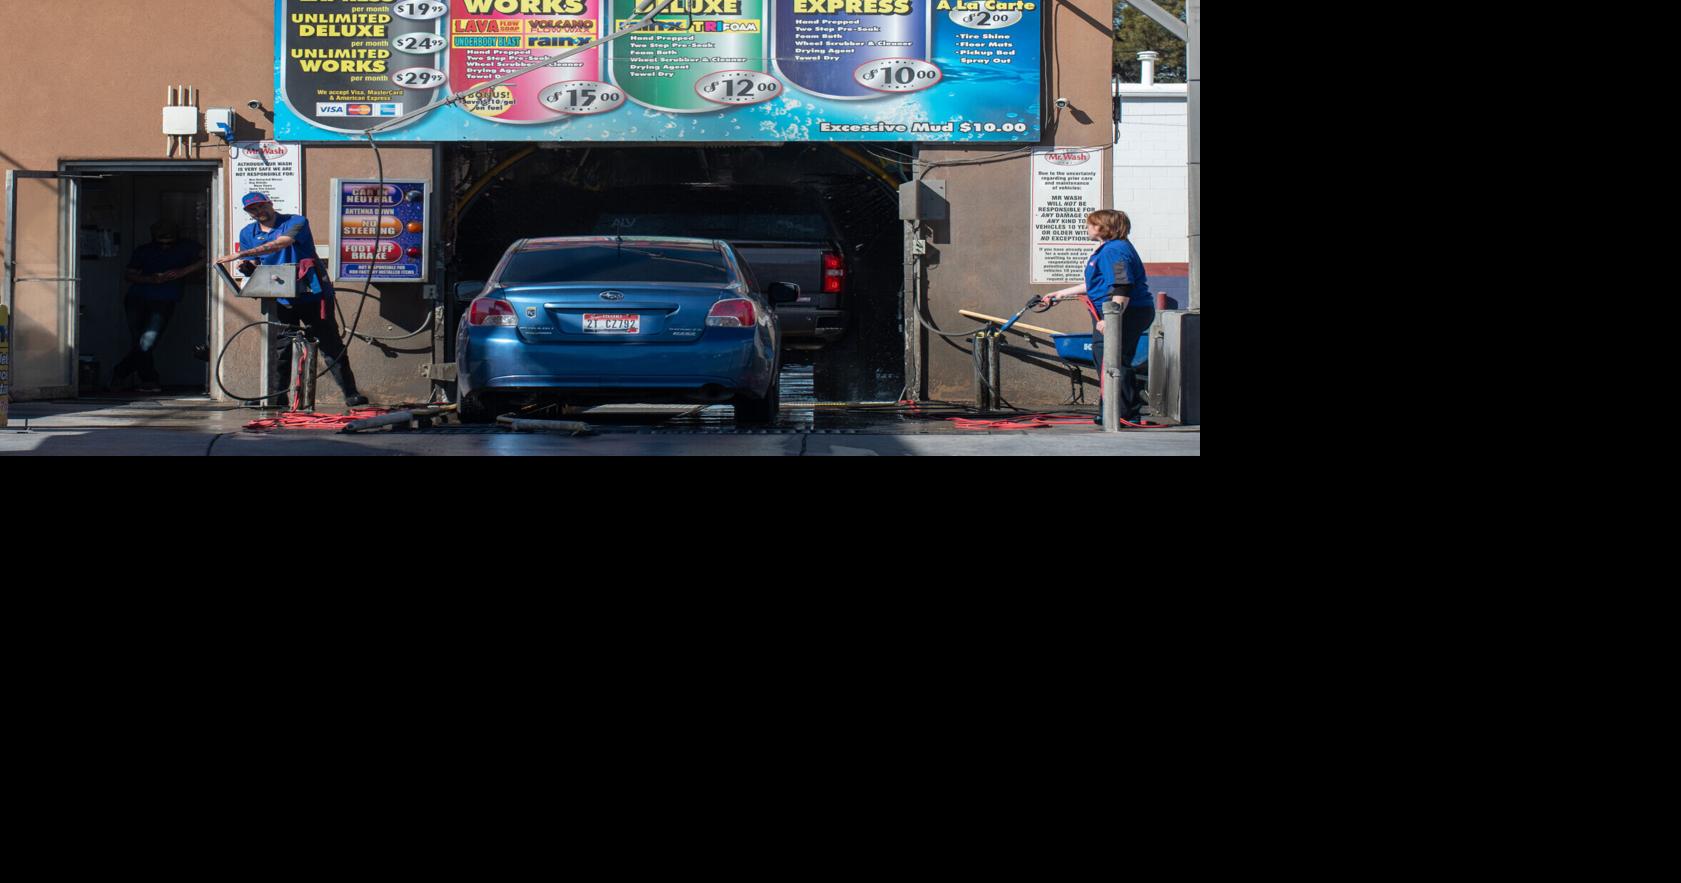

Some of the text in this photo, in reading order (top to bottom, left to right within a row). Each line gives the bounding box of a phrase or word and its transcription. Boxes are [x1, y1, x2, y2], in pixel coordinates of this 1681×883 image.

[464, 0, 584, 14] WORKS
[794, 0, 911, 13] EXPRESS
[937, 0, 1035, 10] A La Carte
[291, 14, 392, 23] UNLIMITED
[455, 20, 499, 32] LAVA
[528, 20, 594, 29] VOLCANO
[300, 25, 385, 37] DELUXE
[454, 37, 521, 46] UNDERBODY BLAST
[290, 49, 390, 58] UNLIMITED
[299, 60, 386, 72] WORKS
[820, 122, 1026, 132] Excessive Mud $10.00
